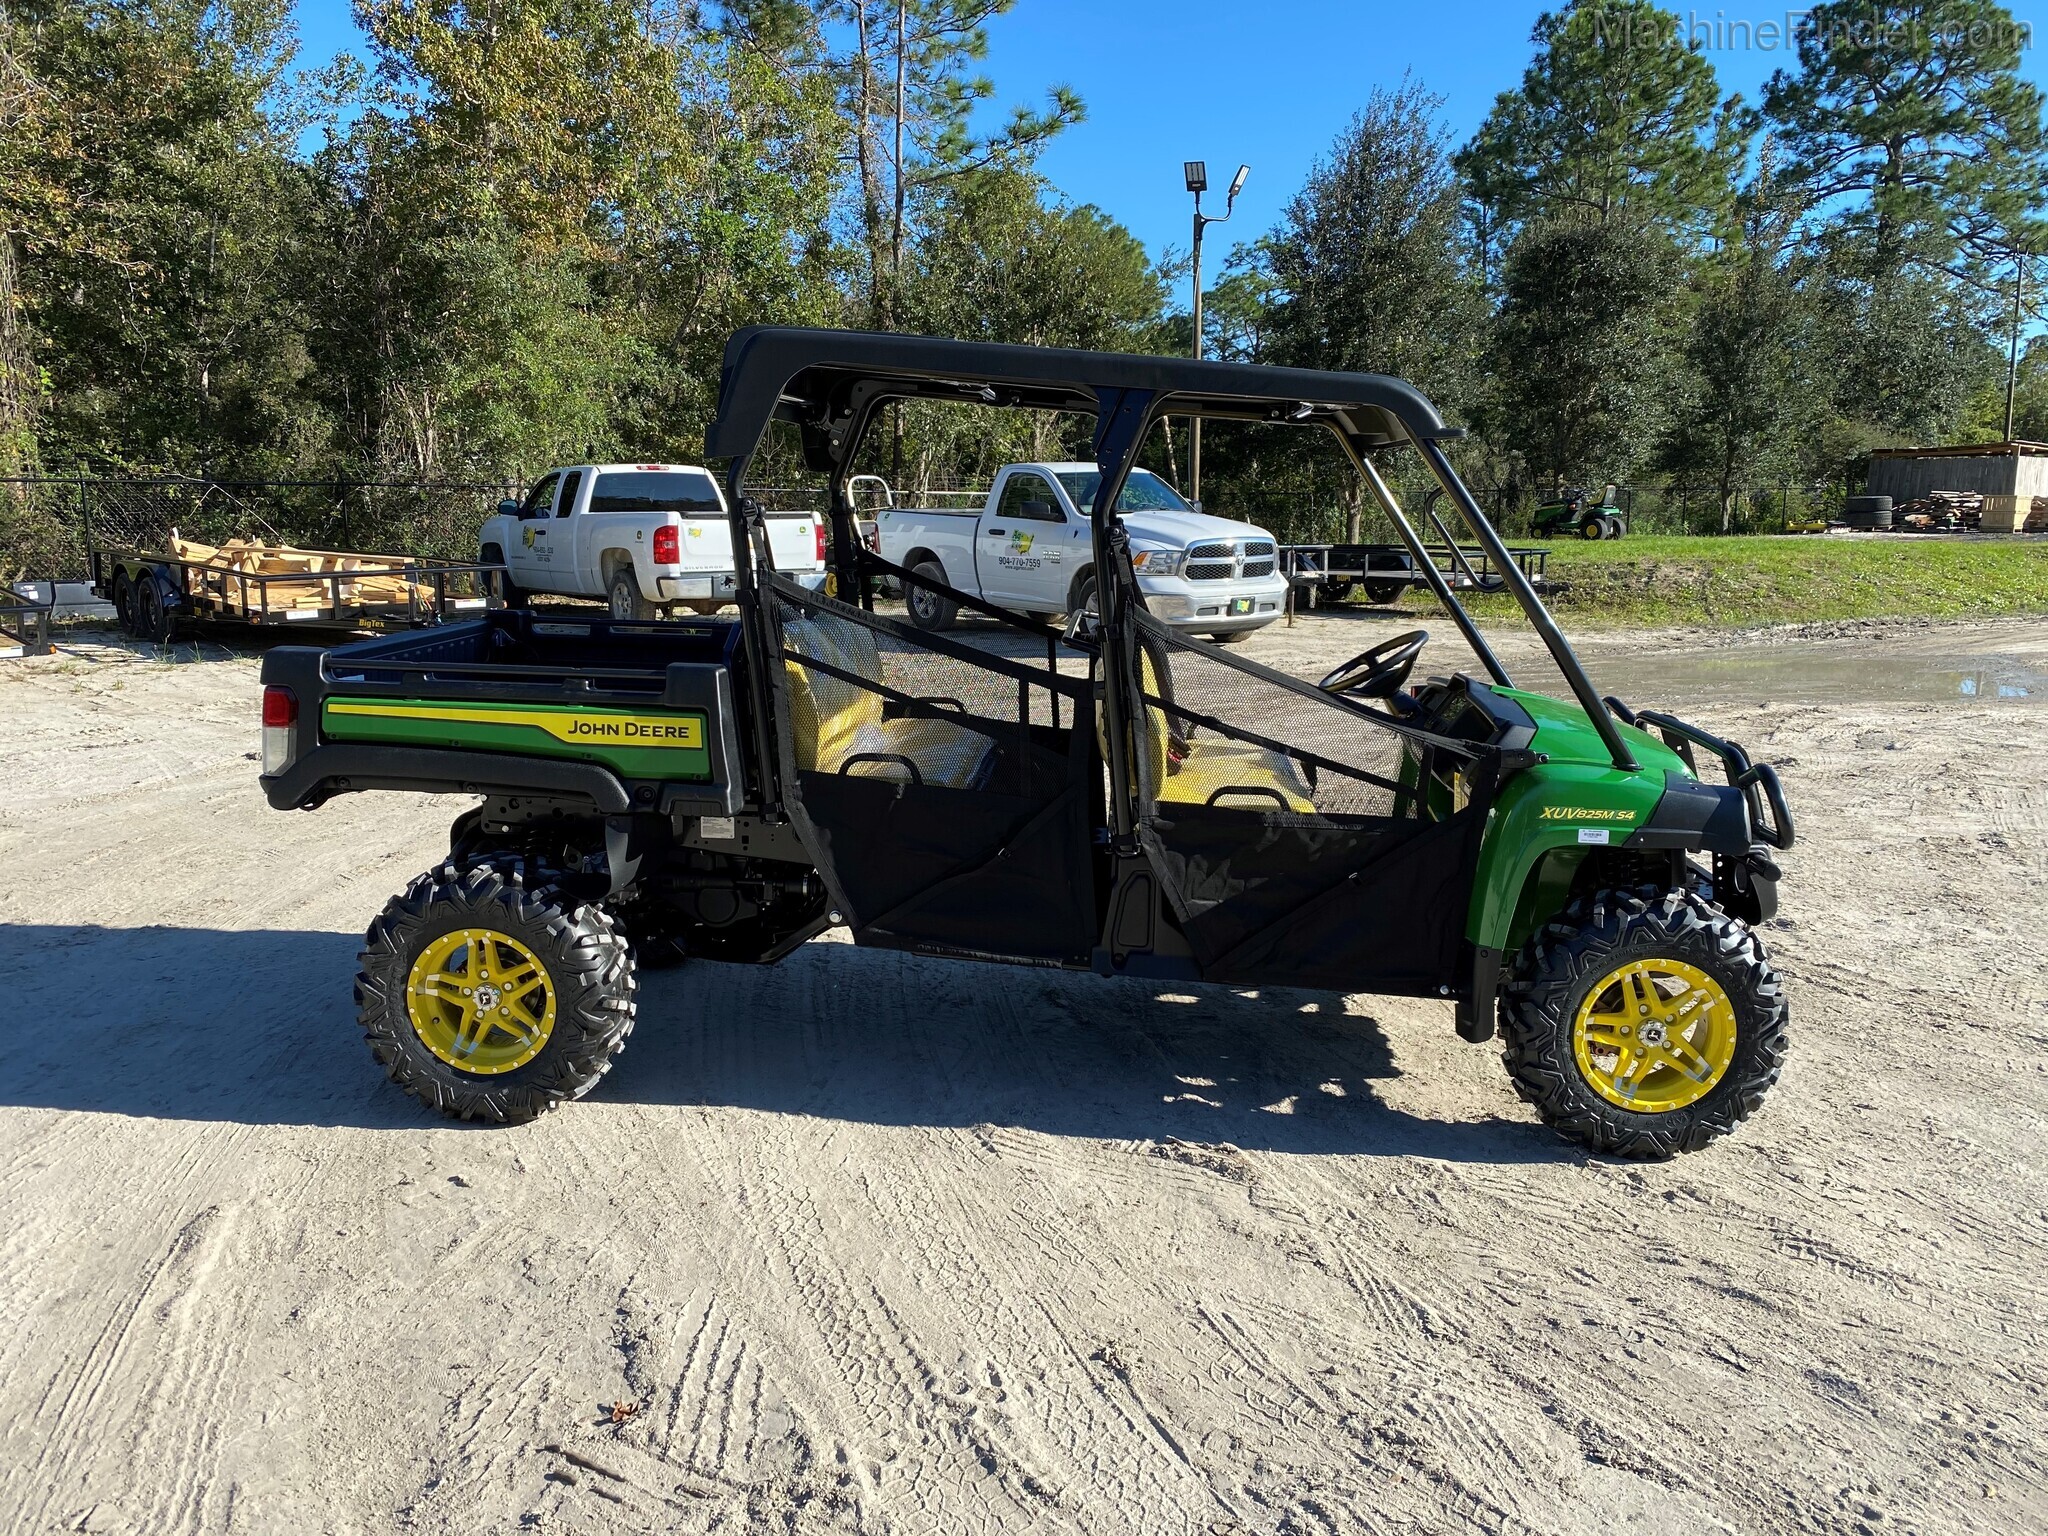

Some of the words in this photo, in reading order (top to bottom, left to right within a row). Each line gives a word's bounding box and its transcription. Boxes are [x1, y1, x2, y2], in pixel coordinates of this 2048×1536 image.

[998, 556, 1041, 568] 904-770-7559
[358, 618, 386, 629] BigTex
[567, 720, 620, 736] JOHN
[624, 722, 690, 739] DEERE
[1539, 807, 1615, 820] XUV825M
[1615, 811, 1636, 820] S4
